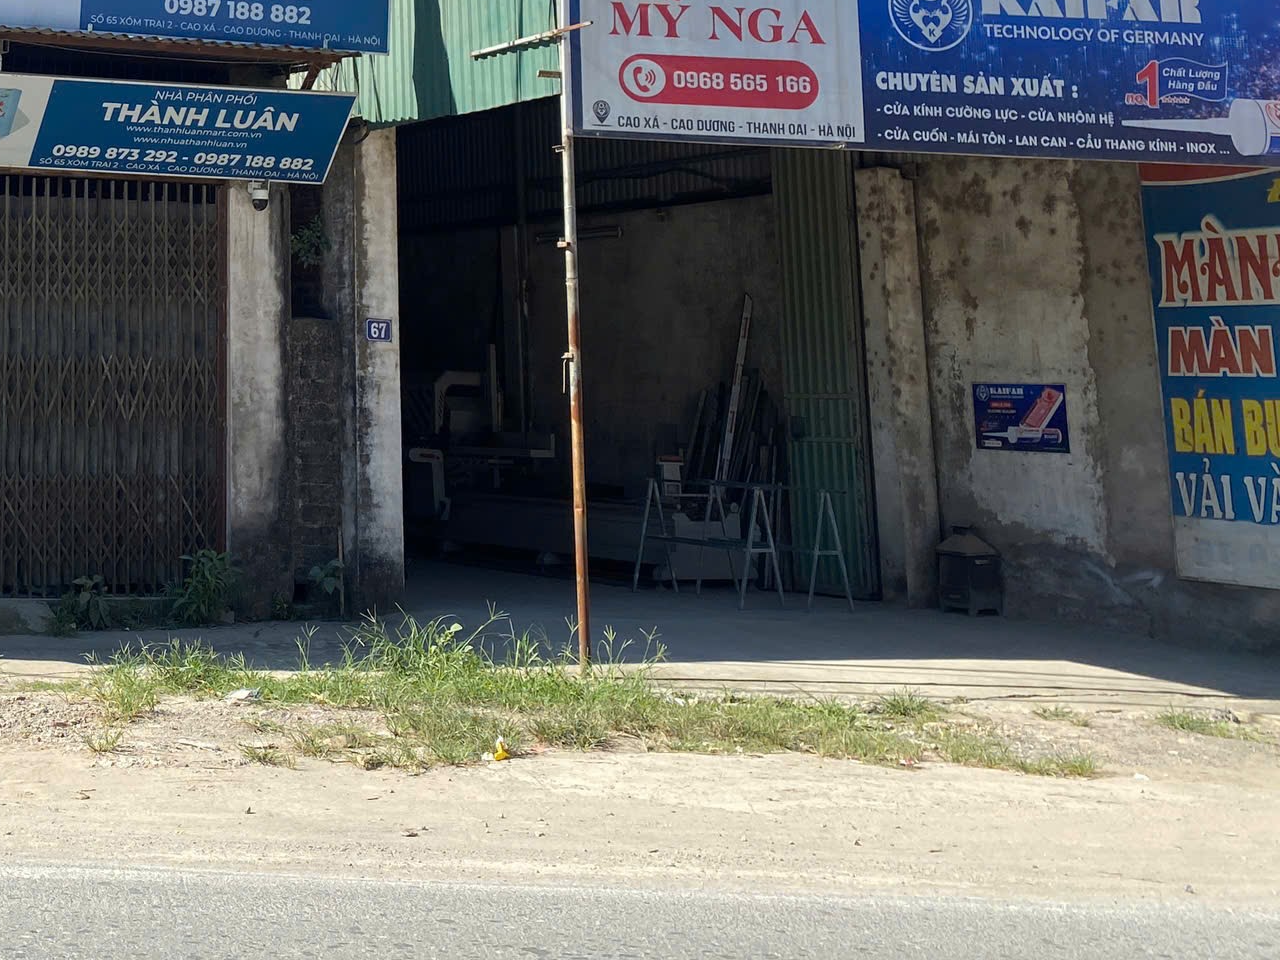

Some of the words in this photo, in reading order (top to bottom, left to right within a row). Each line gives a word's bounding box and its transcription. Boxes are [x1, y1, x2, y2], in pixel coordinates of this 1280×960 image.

[227, 0, 264, 21] 188
[270, 4, 312, 25] 882
[106, 16, 117, 25] 65
[167, 21, 173, 30] 2
[180, 22, 201, 31] CAO
[203, 23, 216, 32] XÁ
[223, 25, 244, 35] CAO
[246, 26, 281, 38] DƯƠNG
[289, 30, 320, 40] THANH
[348, 34, 361, 44] HÀ
[363, 34, 381, 47] NỘI
[708, 7, 826, 45] NGA
[983, 23, 1095, 42] TECHNOLOGY
[1098, 27, 1119, 43] OF
[1123, 29, 1205, 47] GERMANY
[673, 70, 724, 90] 0968
[730, 73, 768, 92] 565
[775, 75, 811, 94] 166
[876, 70, 957, 93] CHUYÊN
[963, 71, 1005, 95] SẢN
[1010, 73, 1065, 98] XUẤT
[1162, 67, 1186, 78] Chất
[1189, 69, 1221, 80] Lượng
[1168, 79, 1195, 91] Hàng
[155, 90, 183, 101] NHÀ
[186, 91, 223, 103] PHÂN
[225, 92, 258, 105] PHỐI
[102, 100, 209, 127] THÀNH
[215, 106, 300, 132] LUÂN
[617, 115, 641, 128] CAO
[643, 114, 660, 130] XÁ
[670, 118, 694, 131] CAO
[696, 119, 735, 133] DƯƠNG
[746, 121, 786, 135] THANH
[788, 123, 807, 136] OAI
[818, 122, 833, 137] HÀ
[837, 124, 856, 140] NỘI
[884, 101, 910, 116] CỬA
[914, 103, 943, 117] KÍNH
[946, 104, 992, 119] CƯỜNG
[995, 108, 1019, 123] LỰC
[1028, 107, 1055, 122] CỬA
[1058, 111, 1096, 124] NHÔM
[1099, 111, 1114, 127] HỆ
[126, 124, 262, 139] www.thanhluanmart.com.vn
[133, 136, 248, 149] www.nhuathanhluan.vn
[884, 126, 910, 141] CỬA
[913, 127, 947, 142] CUỐN
[957, 131, 979, 143] MÁI
[982, 131, 1005, 144] TÔN
[1016, 135, 1038, 146] LAN
[1041, 136, 1066, 147] CAN
[1105, 139, 1145, 151] THANG
[1149, 138, 1177, 152] KÍNH
[1186, 143, 1216, 154] INOX
[52, 144, 101, 158] 0989
[105, 147, 140, 160] 873
[143, 149, 178, 163] 292
[193, 152, 242, 166] 0987
[245, 155, 276, 168] 188
[279, 157, 314, 171] 882
[54, 158, 65, 166] 65
[126, 162, 146, 170] CAO
[231, 168, 263, 176] THANH
[1155, 216, 1280, 306] MÀN
[370, 322, 387, 338] 67
[1168, 316, 1276, 377] MÀN
[1170, 389, 1235, 455] BÁN
[1175, 457, 1236, 520] VẢI
